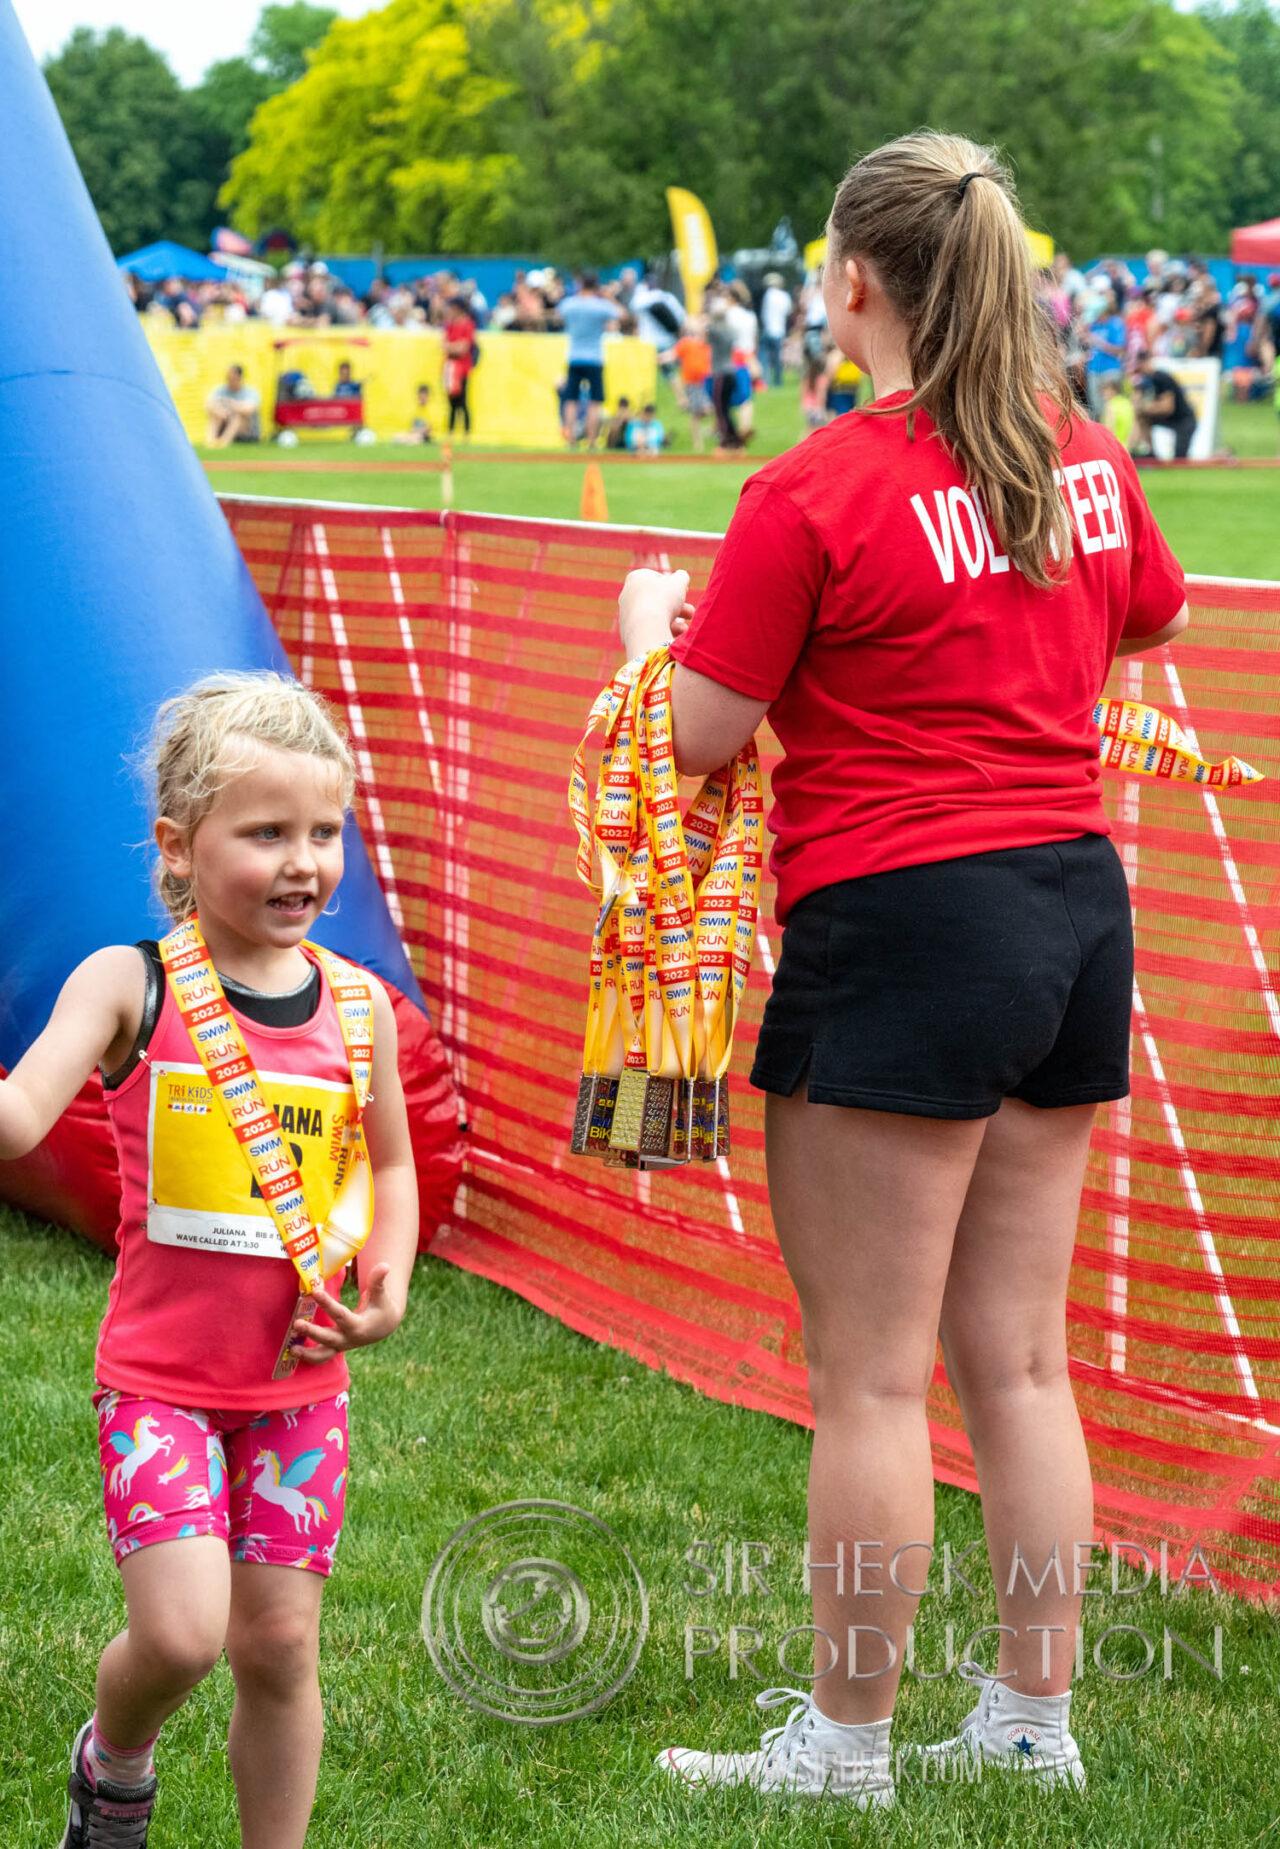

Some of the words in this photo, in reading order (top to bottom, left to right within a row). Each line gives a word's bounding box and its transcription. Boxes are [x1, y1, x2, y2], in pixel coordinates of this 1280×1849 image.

[649, 692, 666, 703] 2022
[1108, 706, 1120, 732] 2022
[1124, 708, 1137, 736] RUN
[650, 727, 668, 740] RUN
[1158, 717, 1169, 742] 2022
[652, 746, 668, 758] 2022
[1126, 741, 1140, 768] RUN
[613, 756, 631, 766] RUN
[1161, 752, 1173, 773] 2022
[1177, 757, 1189, 778] RUN
[609, 775, 630, 784] 2022
[654, 782, 673, 796] RUN
[656, 801, 674, 813] 2022
[696, 801, 720, 817] RUN
[601, 809, 630, 820] RUN
[601, 829, 630, 837] 2022
[690, 818, 714, 834] 2022
[659, 836, 679, 850] RUN
[663, 856, 681, 869] 2022
[631, 872, 648, 882] RU
[705, 880, 735, 890] RUN
[660, 898, 674, 907] RU
[704, 900, 732, 908] 2022
[624, 926, 644, 936] RU
[166, 937, 198, 955] RUN
[697, 936, 728, 945] RUN
[734, 941, 750, 955] RUN
[171, 951, 202, 968] 2022
[661, 952, 691, 963] RUN
[735, 960, 747, 972] 2022
[664, 970, 690, 981] 2022
[181, 984, 216, 1004] RUN
[340, 988, 367, 999] 2022
[190, 1003, 222, 1022] 2022
[669, 1006, 690, 1018] RUN
[346, 1028, 370, 1038] RUN
[205, 1041, 240, 1062] RUN
[352, 1048, 370, 1059] 2022
[216, 1061, 247, 1080] 2022
[232, 1098, 265, 1120] RUN
[242, 1119, 274, 1138] 2022
[258, 1156, 290, 1177] RUN
[268, 1176, 297, 1195] 2022
[283, 1213, 310, 1235] RUN
[212, 1227, 246, 1238] JULIANA
[176, 1233, 198, 1244] WAVE
[199, 1236, 227, 1247] CALLED
[230, 1240, 242, 1248] AT
[243, 1241, 259, 1249] 3:30
[293, 1233, 315, 1252] 2022
[1007, 1726, 1041, 1742] CONVERSE
